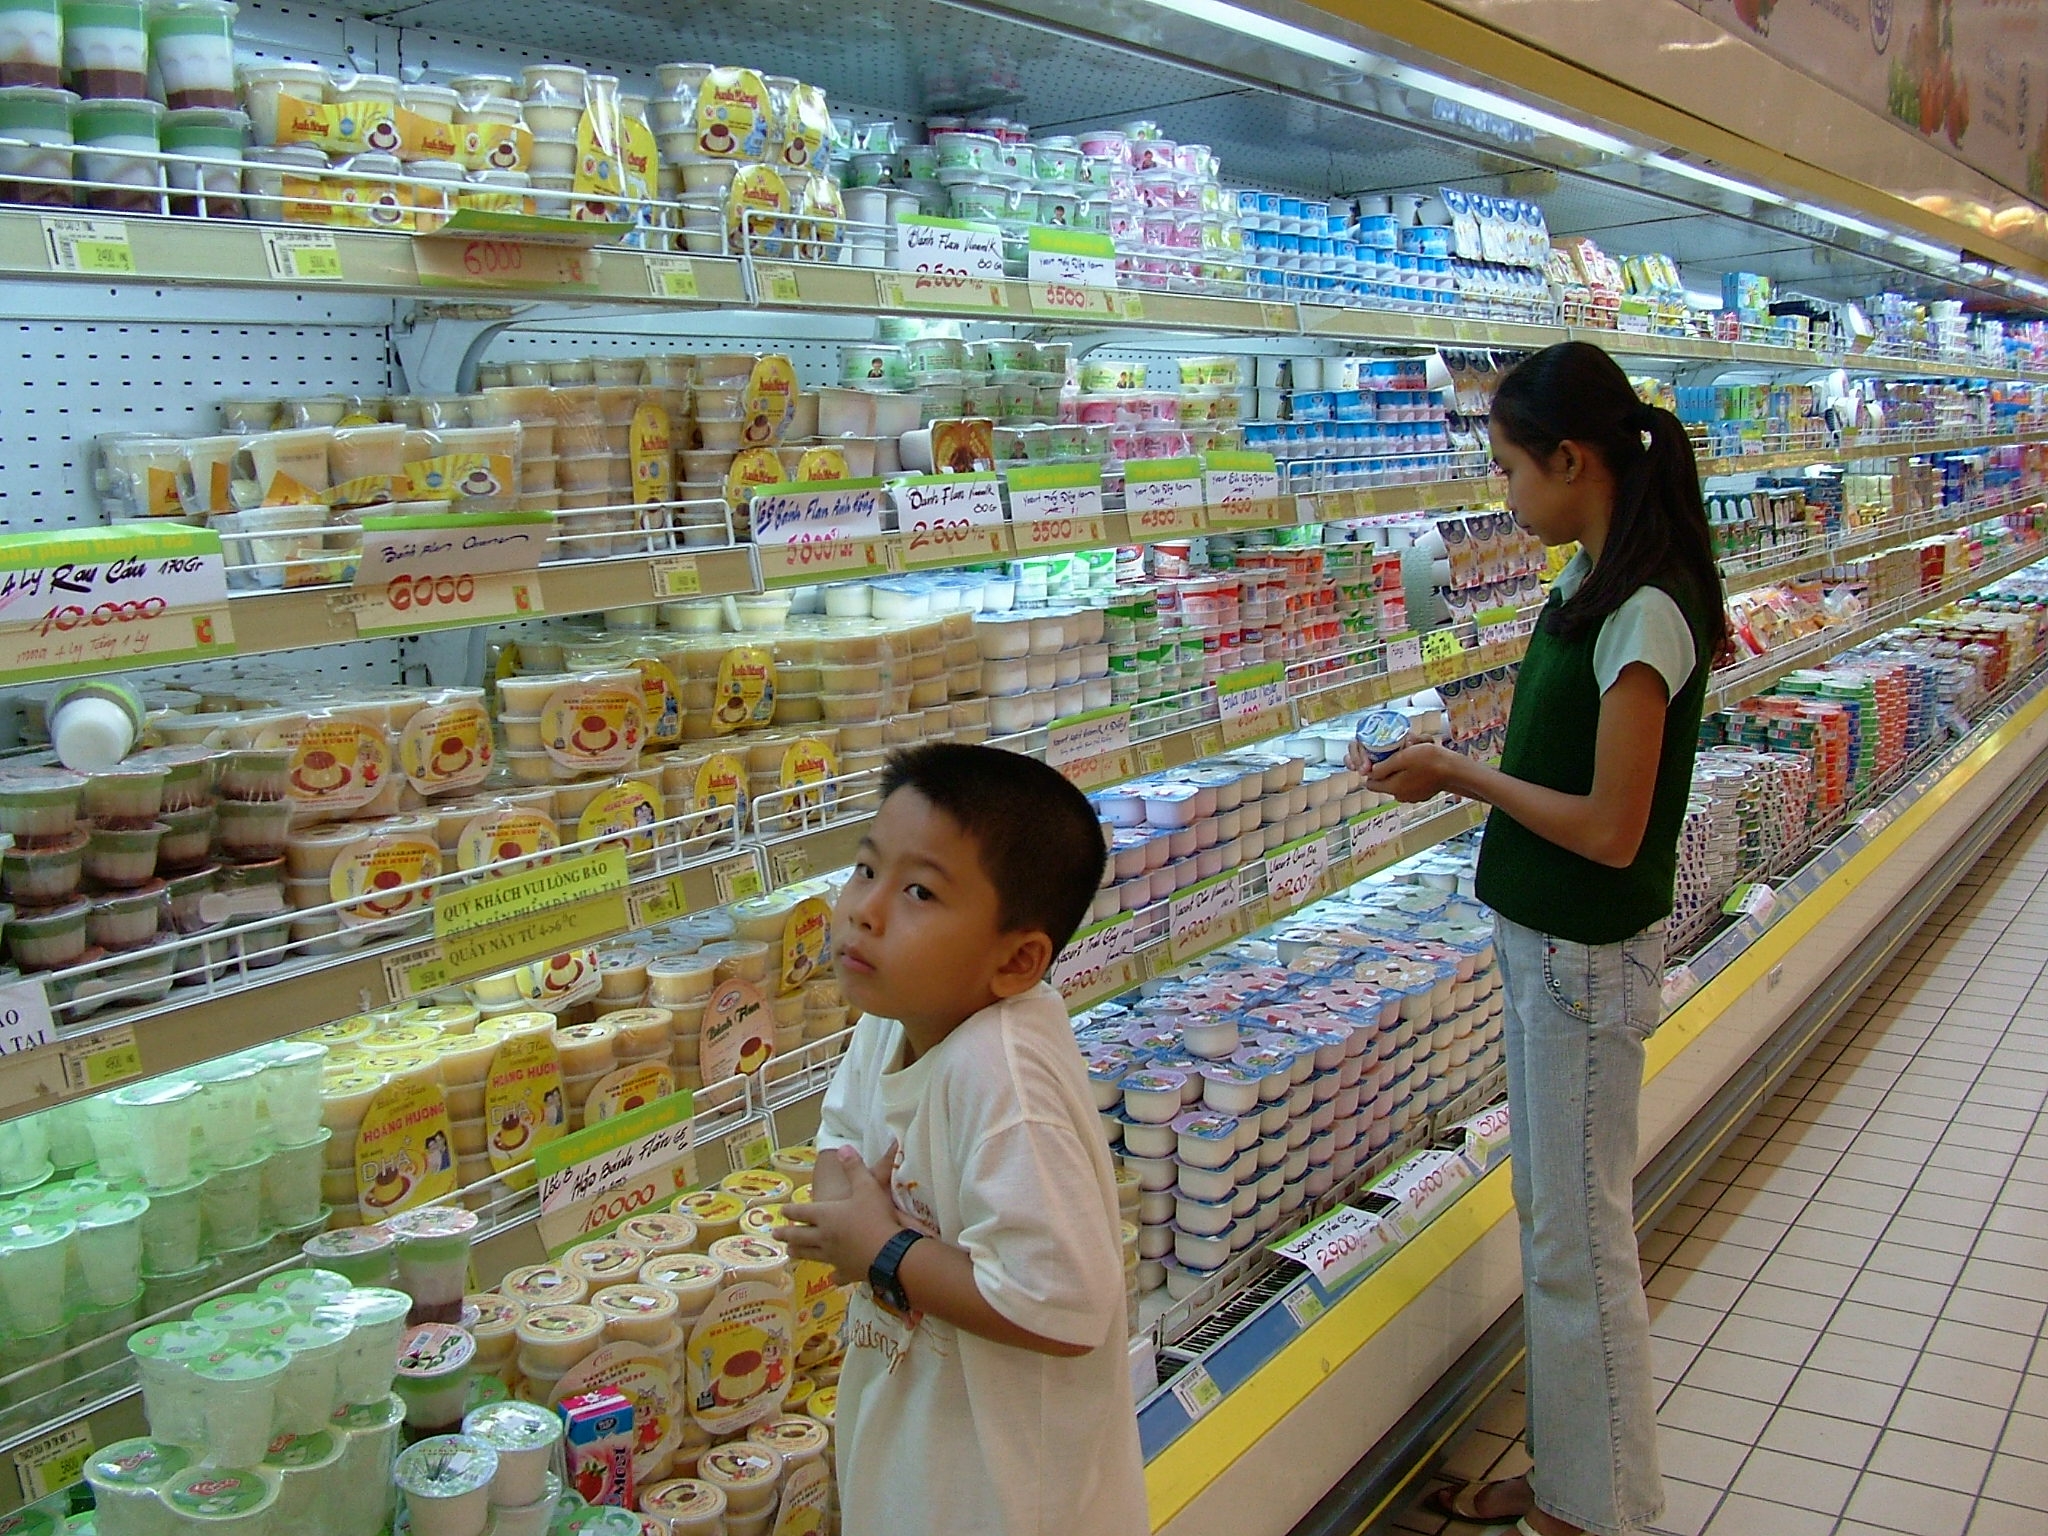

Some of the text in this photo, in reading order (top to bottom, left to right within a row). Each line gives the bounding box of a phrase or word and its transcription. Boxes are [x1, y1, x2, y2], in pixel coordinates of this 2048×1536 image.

[463, 240, 522, 275] 6000
[49, 563, 99, 595] Rau
[105, 555, 149, 584] Câu
[387, 572, 475, 611] 6000
[475, 885, 521, 912] KHÁCH
[523, 880, 547, 897] VUI
[547, 868, 581, 891] LÒNG
[583, 860, 608, 881] BẢO
[734, 1002, 760, 1024] Flan
[362, 1148, 412, 1182] DHA
[599, 1146, 635, 1181] Bánh
[1316, 1233, 1358, 1271] 2900
